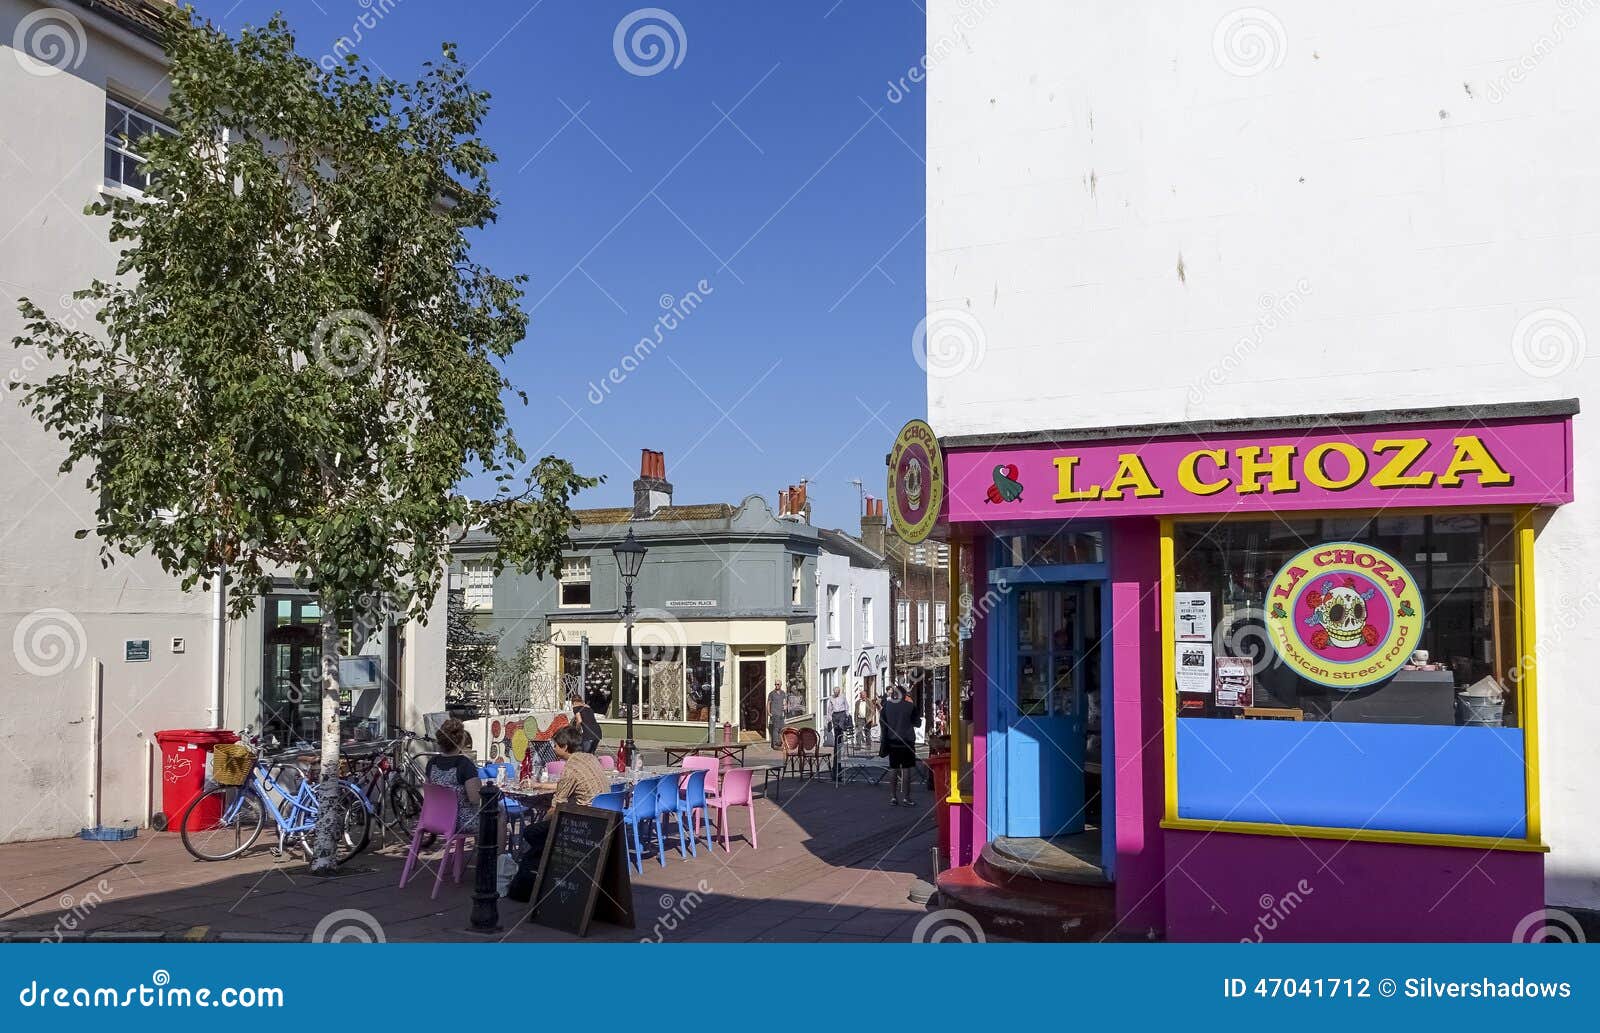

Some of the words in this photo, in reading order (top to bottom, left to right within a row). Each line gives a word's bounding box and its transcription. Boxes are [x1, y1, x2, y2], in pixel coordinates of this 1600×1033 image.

[903, 424, 937, 464] CHOZA
[1051, 453, 1163, 502] LA
[1176, 435, 1514, 497] CHOZA
[1273, 566, 1309, 600] LA
[1312, 549, 1408, 599] CHOZA
[1277, 626, 1330, 678] mexican
[1333, 661, 1385, 680] street
[1385, 625, 1409, 662] food
